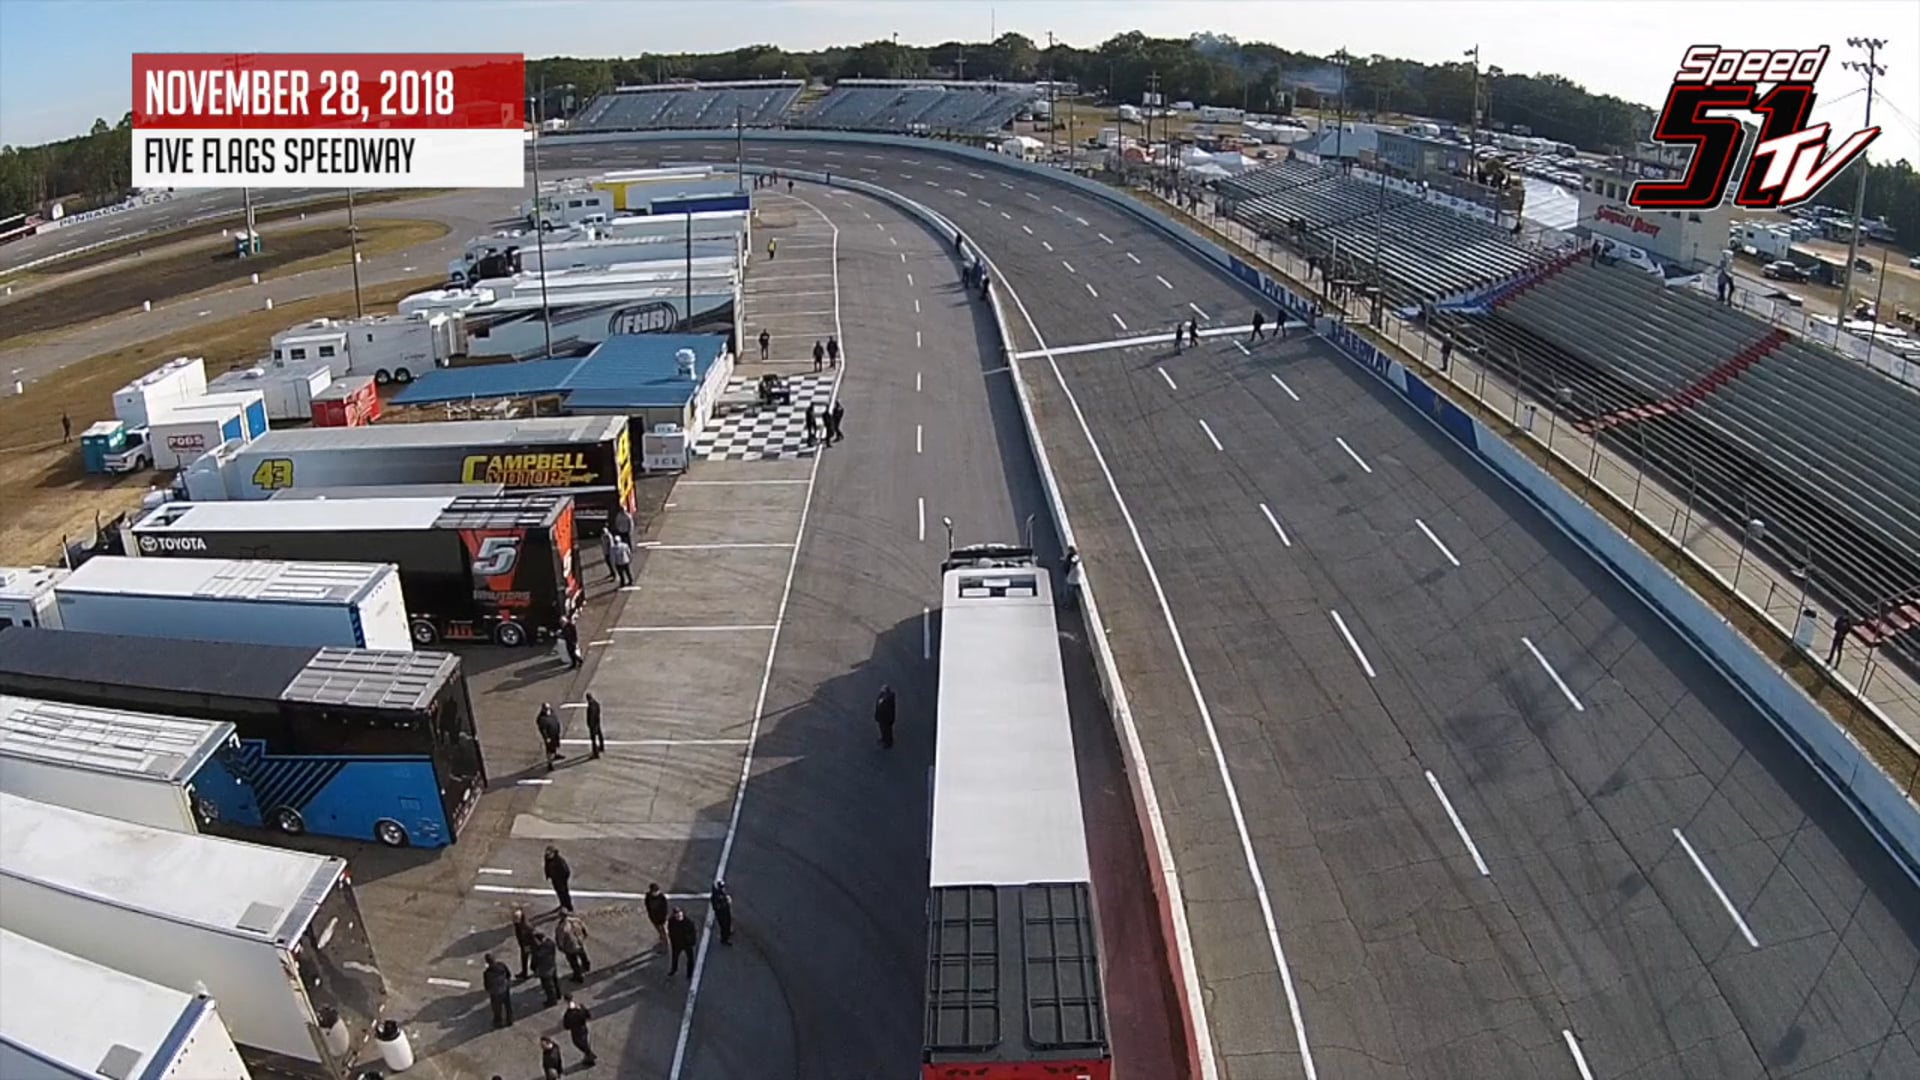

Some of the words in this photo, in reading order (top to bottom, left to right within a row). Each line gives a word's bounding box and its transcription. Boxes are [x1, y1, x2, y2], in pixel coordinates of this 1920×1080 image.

[622, 310, 666, 334] FHR
[168, 436, 203, 447] PODS
[253, 459, 293, 489] 43
[462, 453, 588, 485] CAMPBELL
[158, 537, 207, 550] TOYOTA
[473, 537, 519, 574] 5
